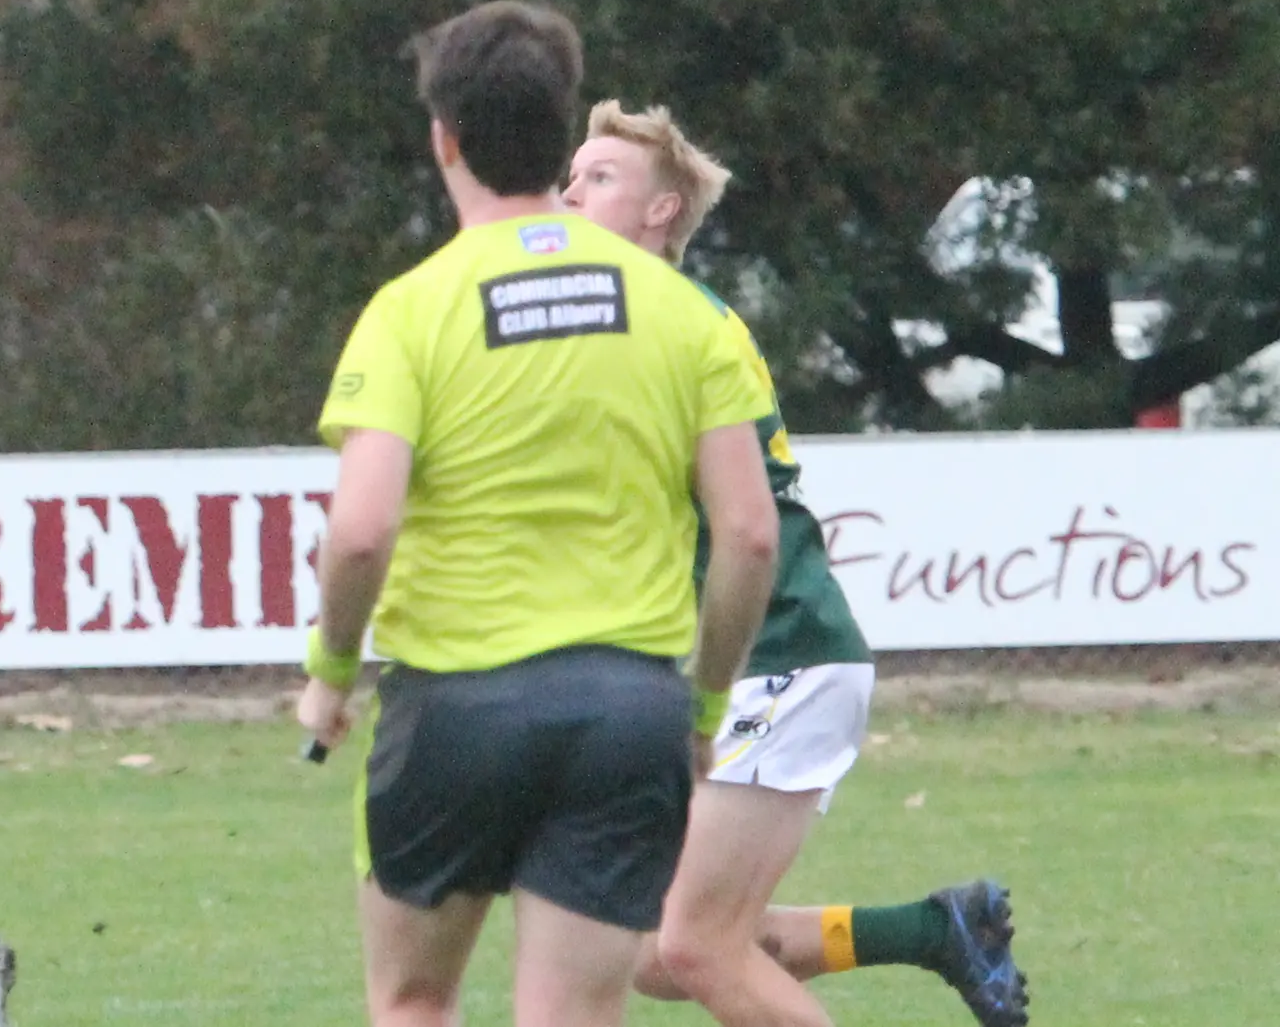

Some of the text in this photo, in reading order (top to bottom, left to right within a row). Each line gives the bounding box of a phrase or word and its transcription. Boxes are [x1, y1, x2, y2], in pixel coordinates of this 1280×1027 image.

[490, 273, 617, 309] COMMERCIAL
[498, 302, 616, 336] CLUB Albury
[820, 506, 1257, 607] Functions
